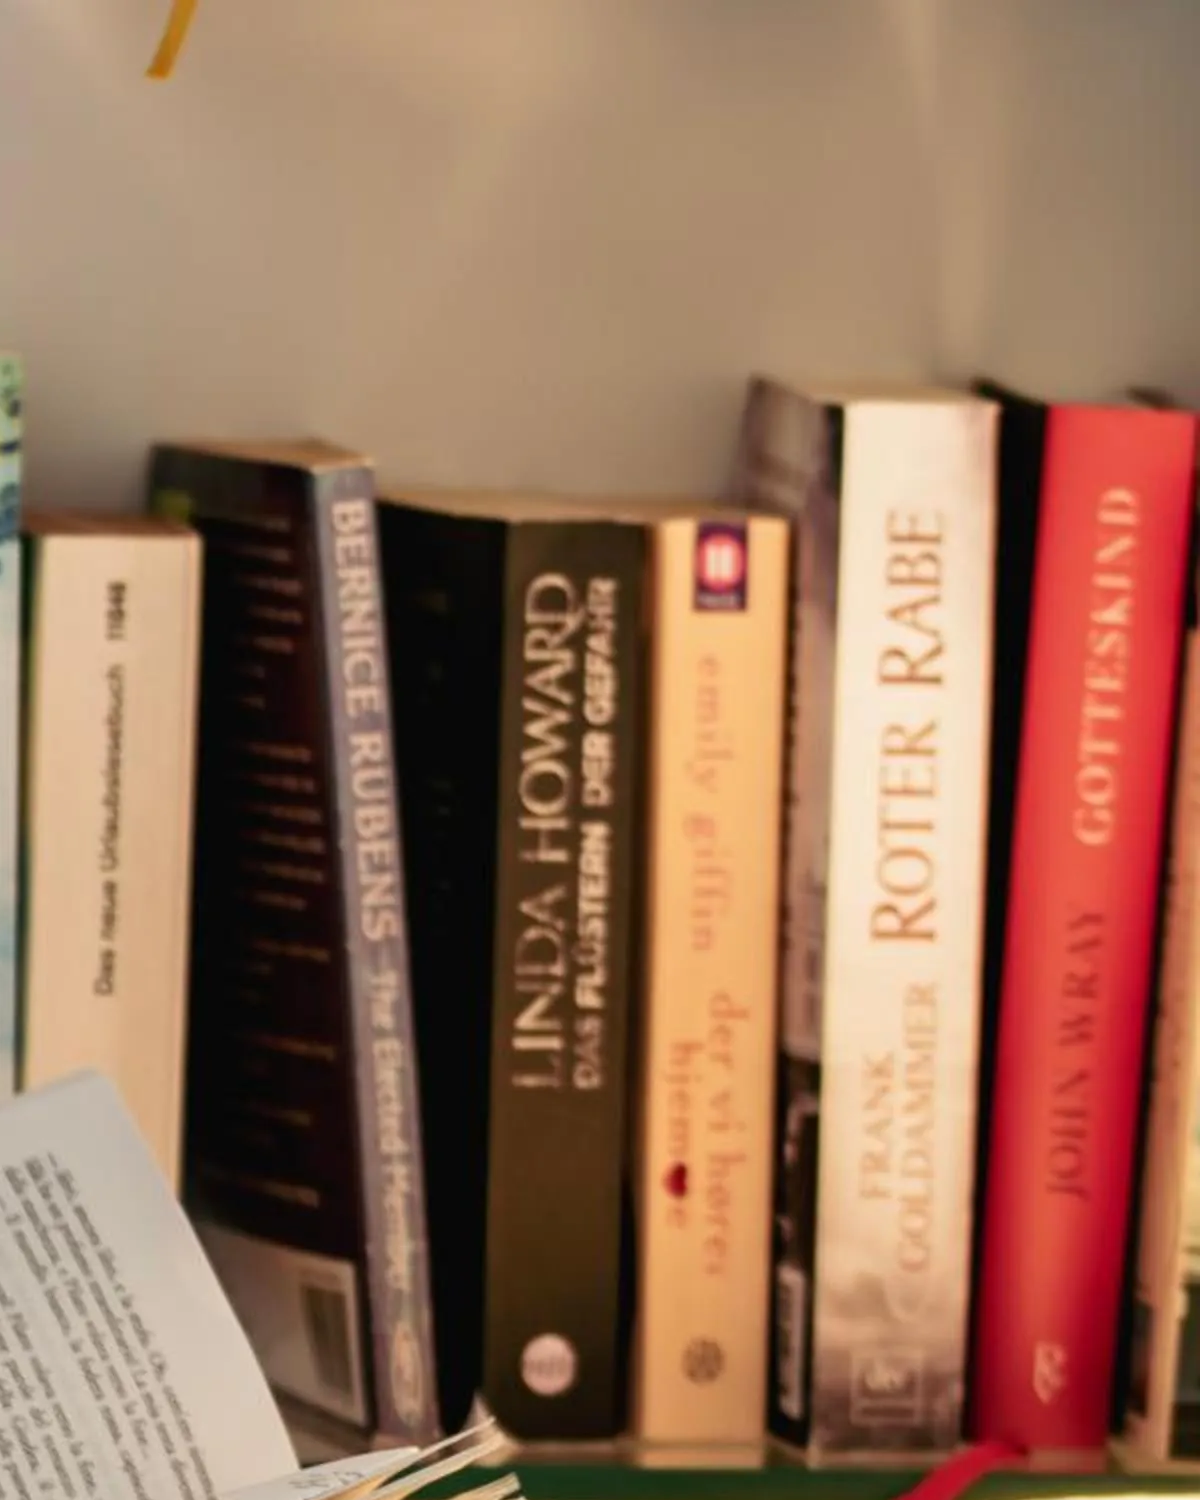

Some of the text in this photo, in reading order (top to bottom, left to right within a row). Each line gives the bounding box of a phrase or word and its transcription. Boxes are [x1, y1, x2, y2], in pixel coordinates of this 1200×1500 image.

[331, 497, 400, 942] BERNICE RUBENS
[683, 654, 742, 793] emily
[869, 508, 947, 946] ROTER RABE
[1070, 485, 1141, 845] GOTTESKIND
[97, 663, 126, 872] Urlaubslesebuch
[511, 573, 583, 1090] LINDA HOWARD
[569, 577, 618, 1090] DAS FLÜSTERN DER GEFAHR
[93, 948, 116, 997] Das
[98, 880, 120, 942] neue
[682, 812, 737, 955] giffin
[368, 970, 400, 1029] The
[705, 992, 749, 1081] der
[1044, 901, 1107, 1203] JOHN WRAY
[661, 1040, 707, 1232] hjeme
[706, 1089, 749, 1135] vi
[860, 1050, 895, 1200] FRANK
[893, 982, 939, 1275] GOLDAMMER
